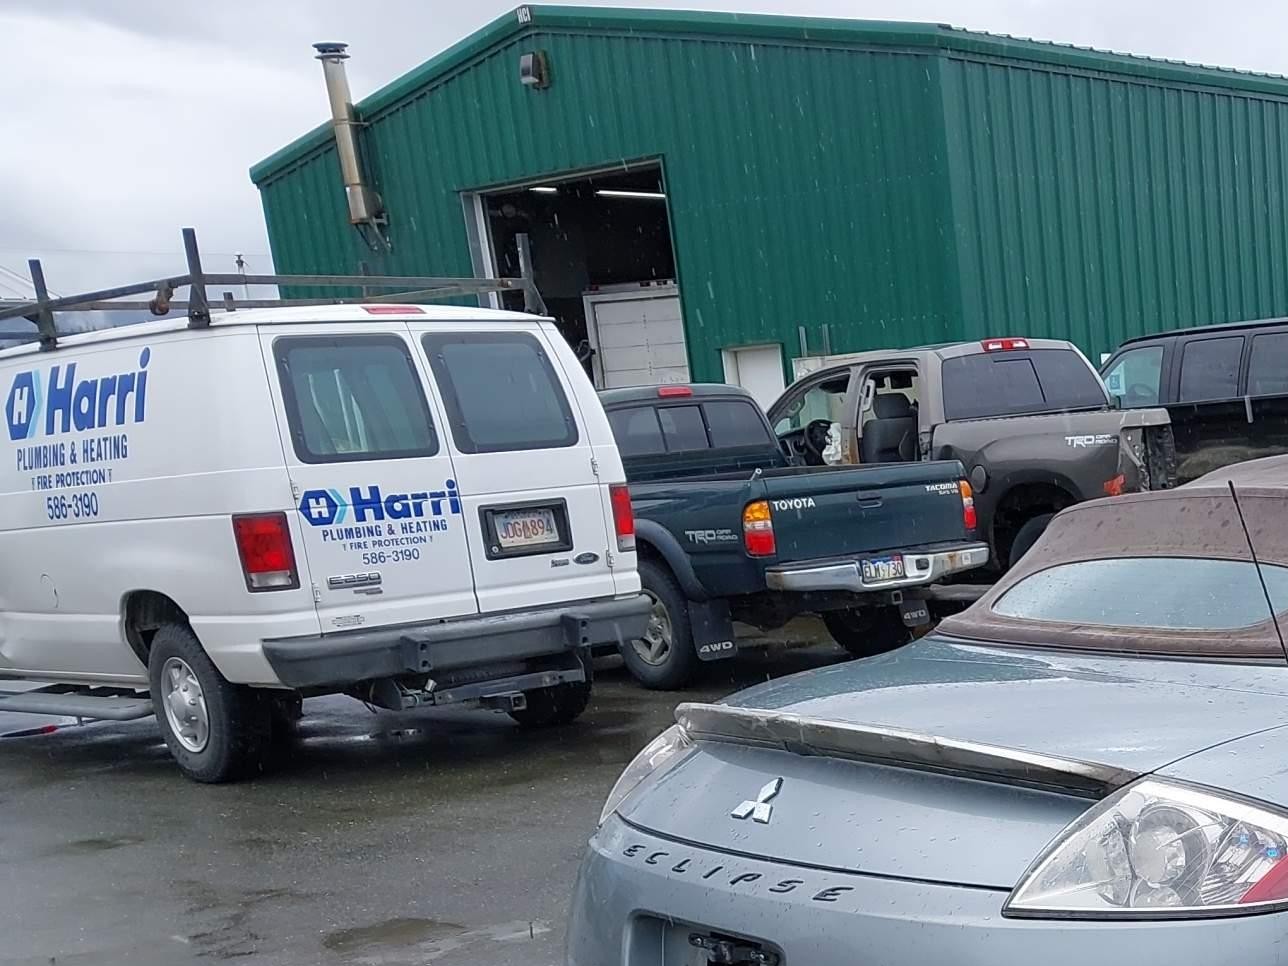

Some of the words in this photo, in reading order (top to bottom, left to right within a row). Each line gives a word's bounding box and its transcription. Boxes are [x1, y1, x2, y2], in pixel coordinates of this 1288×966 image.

[45, 346, 151, 436] Harri
[1064, 435, 1095, 448] TRD
[17, 441, 66, 471] PLUMBING
[69, 441, 77, 465] &
[82, 434, 128, 463] HEATING
[37, 474, 53, 491] FIRE
[55, 468, 107, 489] PROTECTION
[925, 482, 958, 492] TACOMA
[47, 492, 99, 520] 586-3190
[350, 479, 461, 522] Harri
[772, 498, 816, 512] TOYOTA
[322, 524, 382, 542] PLUMBING
[387, 523, 396, 536] &
[401, 519, 448, 535] HEATING
[685, 530, 716, 544] TRD
[350, 541, 368, 551] FIRE
[372, 536, 427, 550] PROTECTION
[362, 548, 420, 565] 586-3190
[700, 641, 733, 653] 4WD
[623, 844, 854, 902] ECLIPSE
